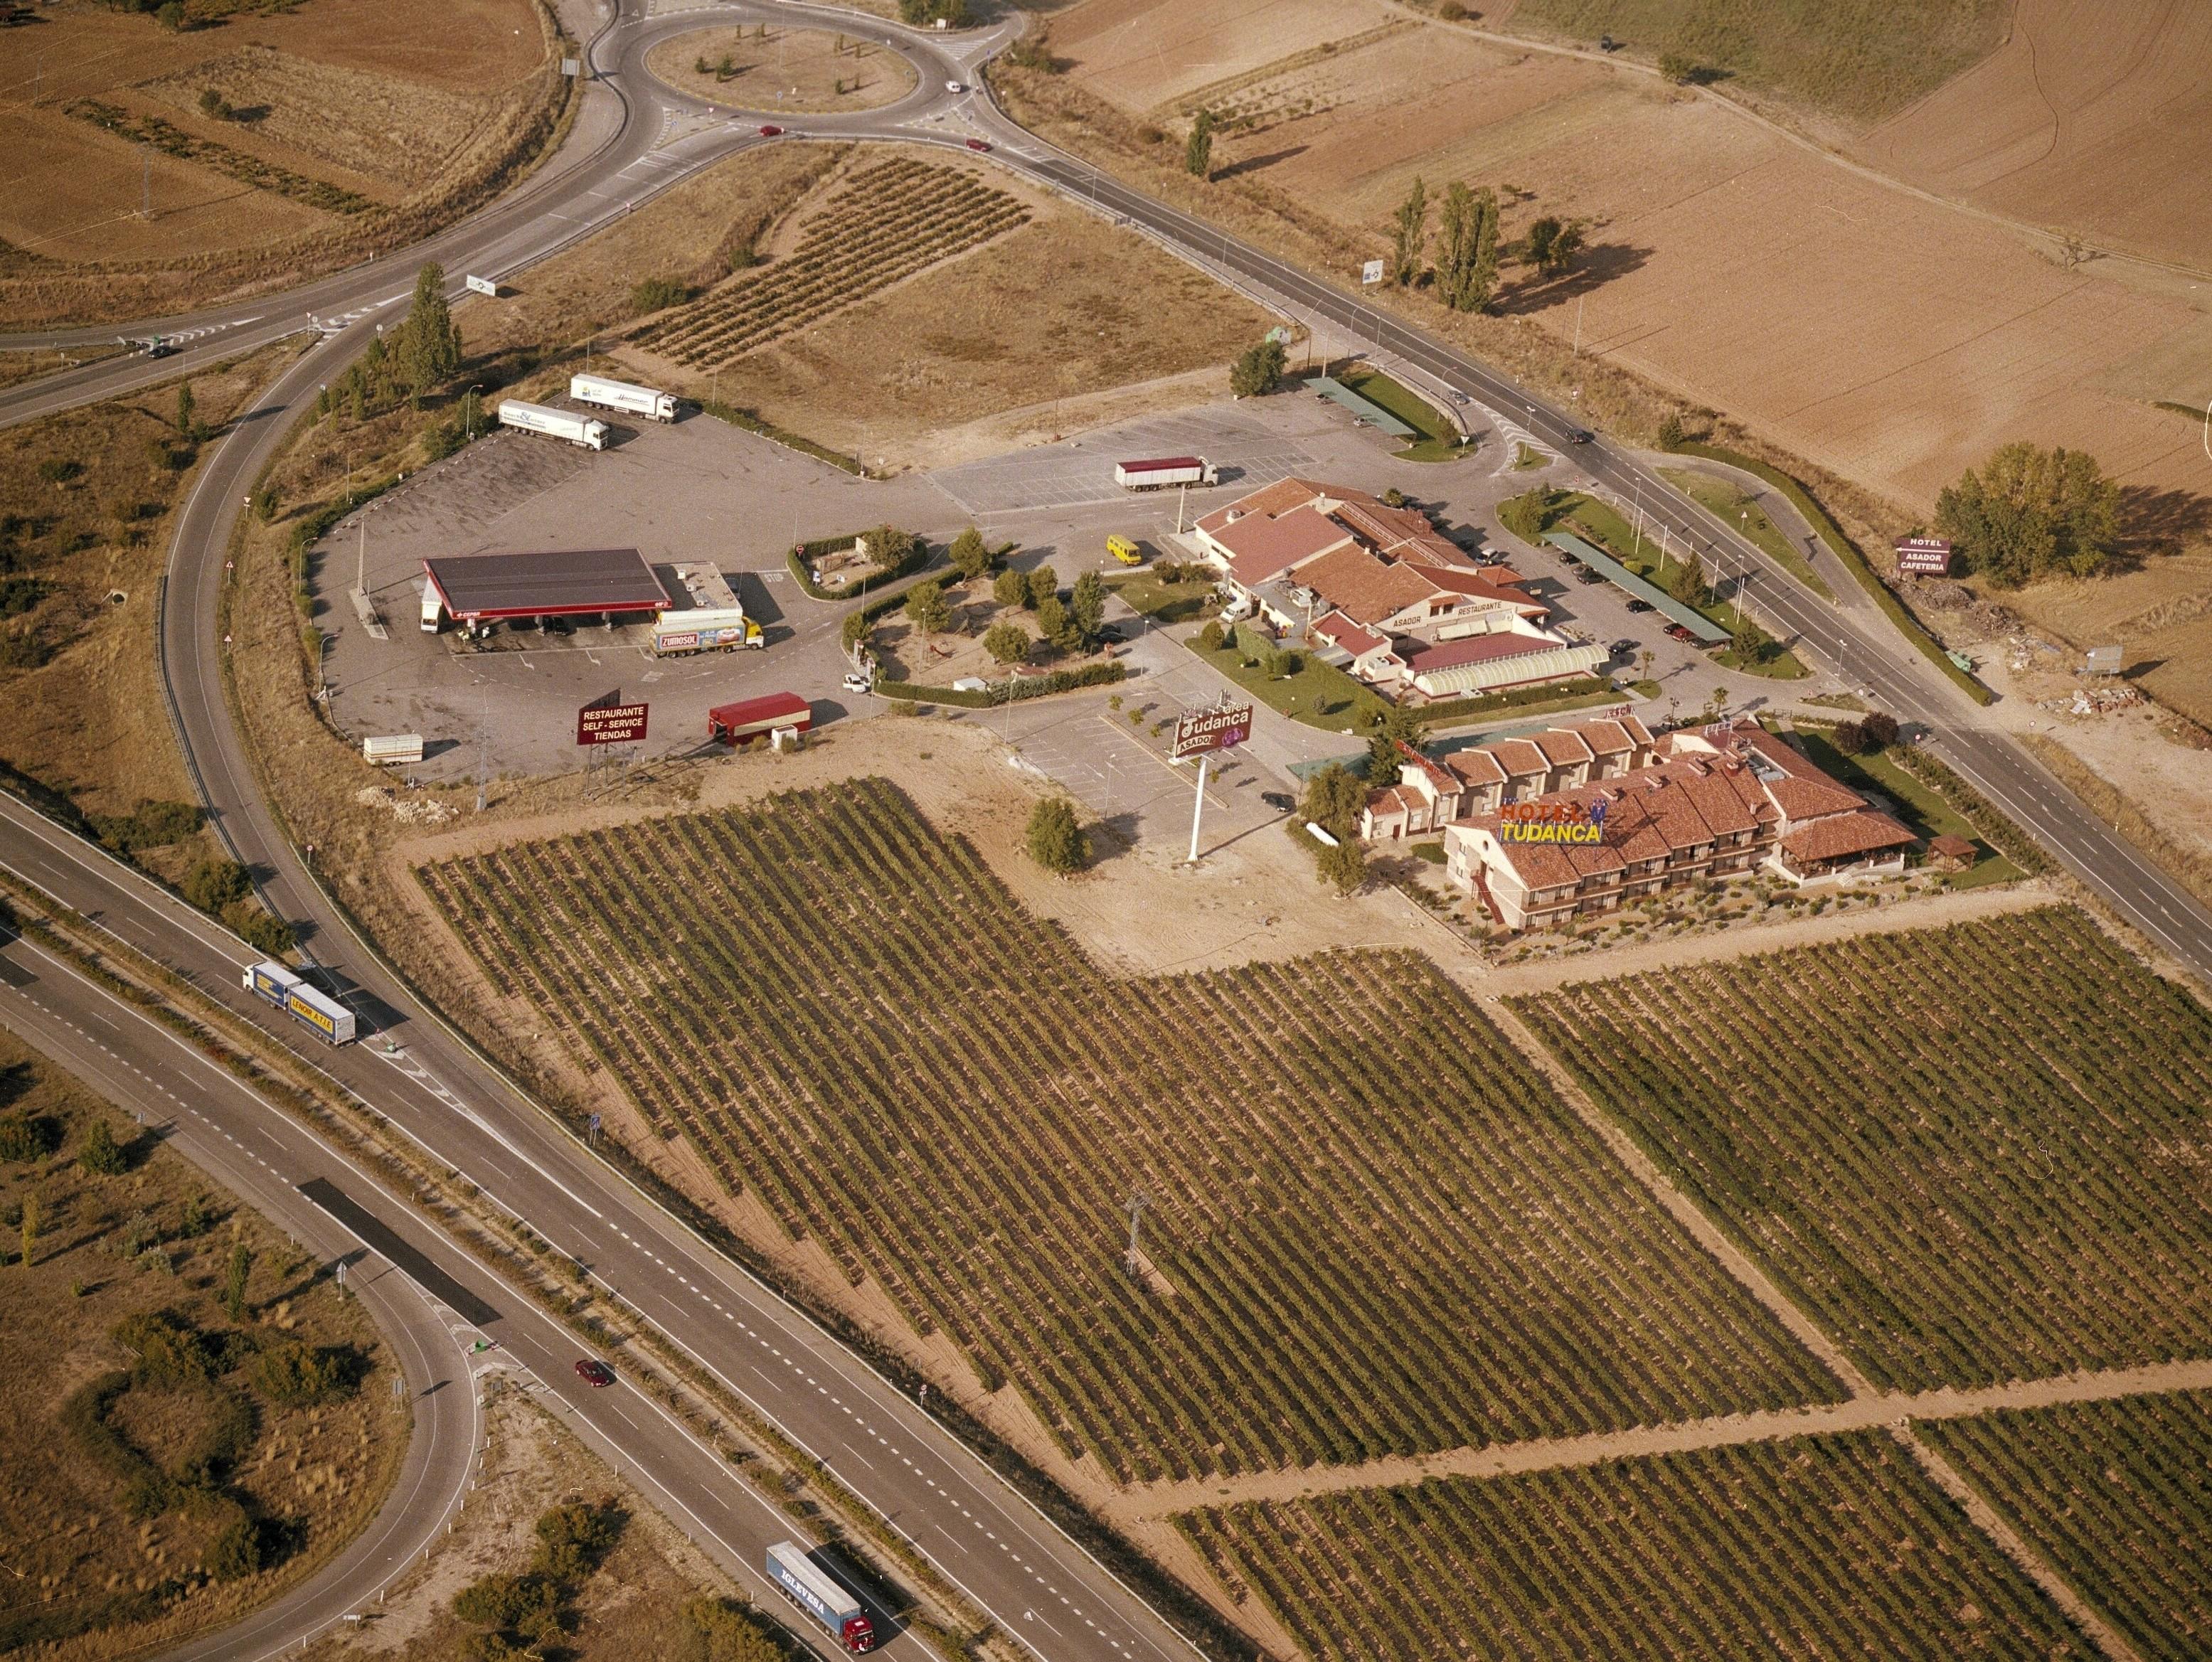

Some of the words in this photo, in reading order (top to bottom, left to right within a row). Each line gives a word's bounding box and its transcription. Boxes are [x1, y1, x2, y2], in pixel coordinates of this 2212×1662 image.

[1457, 601, 1502, 616] RESTAURANTE
[1393, 616, 1421, 627] ASADOR
[584, 707, 644, 720] RESTAURANTE
[583, 722, 602, 731] SELF
[609, 718, 642, 728] SERVICE
[1181, 711, 1249, 737] Tudanca
[594, 730, 631, 740] TIENDAS
[1180, 736, 1215, 752] ASADOR
[1501, 804, 1583, 821] HOTEL
[1502, 824, 1600, 843] TUDANCA
[292, 998, 312, 1016] LENOIR
[781, 1569, 824, 1614] IGLEVESA
